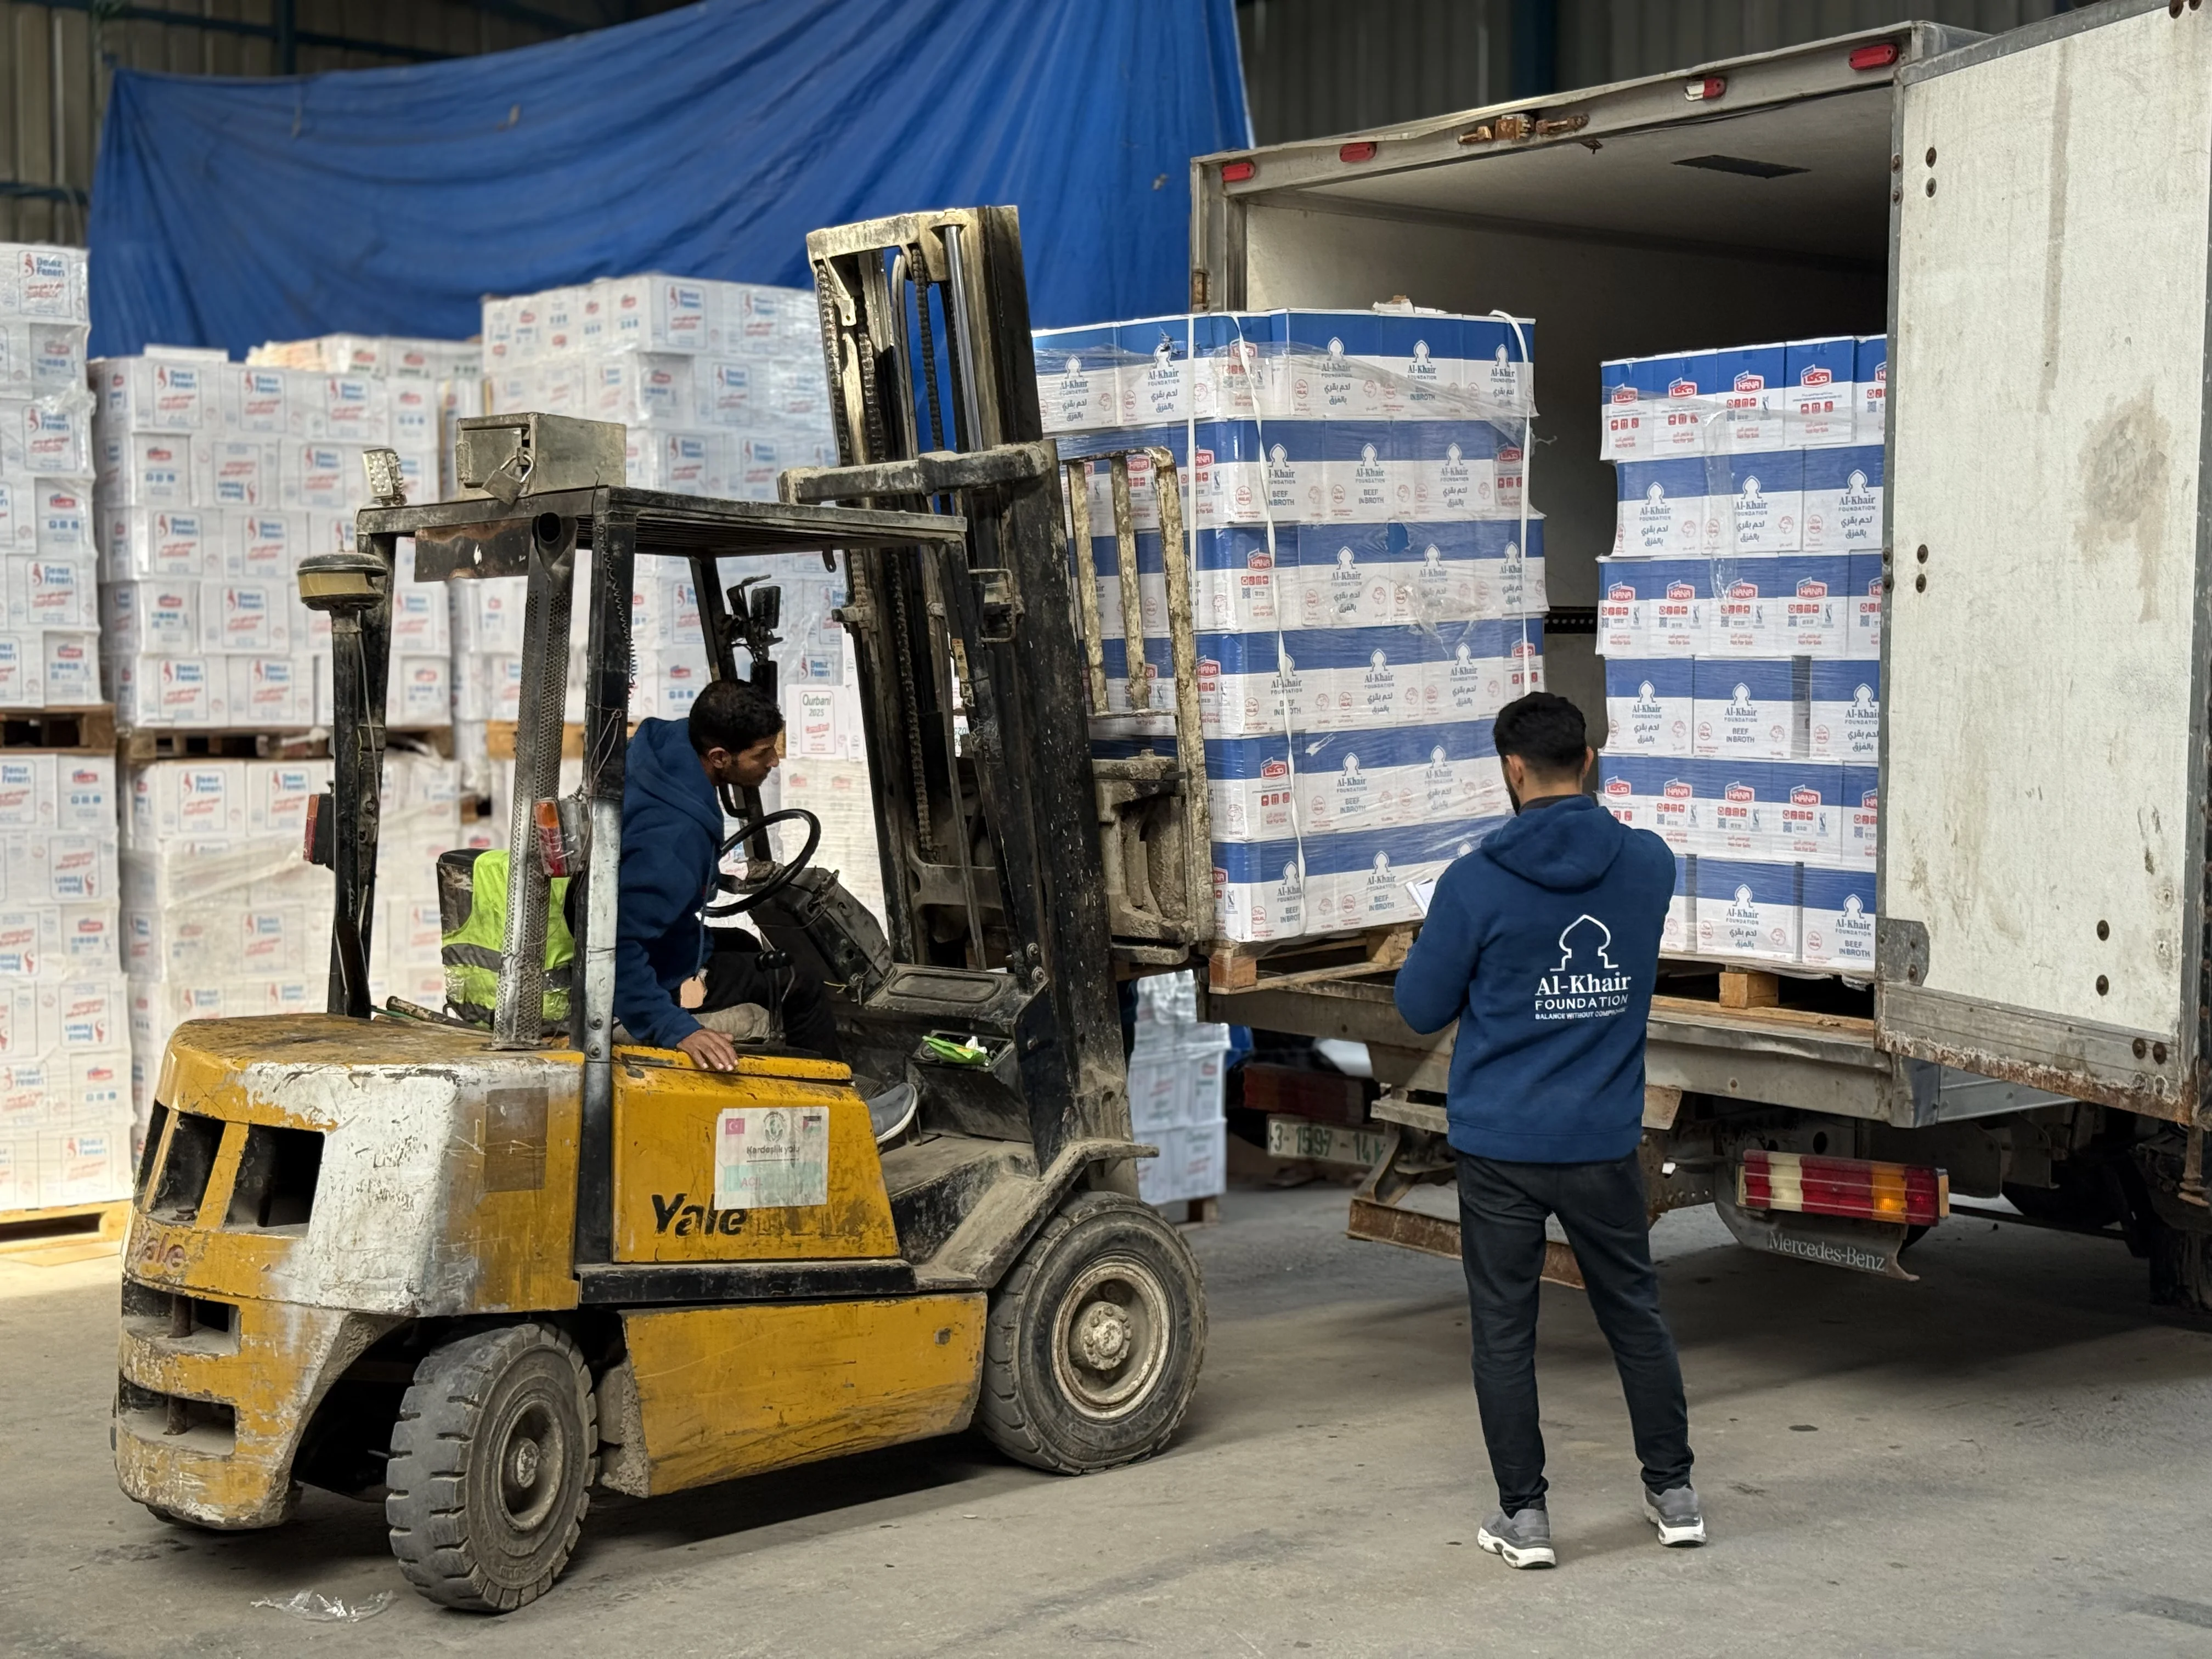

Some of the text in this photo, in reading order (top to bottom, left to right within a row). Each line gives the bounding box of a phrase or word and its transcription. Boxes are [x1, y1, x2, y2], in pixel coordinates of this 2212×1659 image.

[1321, 362, 1351, 372] Al-Khair
[1408, 364, 1436, 374] Al-Khair
[1148, 368, 1179, 380] Al-Khair
[1060, 379, 1089, 390] Al-Khair
[1268, 469, 1295, 478] l-Khair
[1356, 468, 1385, 477] Al-Khair
[1735, 500, 1768, 510] Al-Khair
[1839, 495, 1876, 505] Al-Khair
[1640, 506, 1671, 515] Al-Khair
[1251, 559, 1271, 567] HANA
[1500, 565, 1522, 574] Al-Khai
[1331, 571, 1361, 580] Al-Khair
[1612, 591, 1632, 599] HANA
[1670, 590, 1691, 599] HANA
[1732, 589, 1753, 597] HANA
[1800, 588, 1822, 596] HANA
[1451, 666, 1477, 676] Al-Khair
[1364, 673, 1394, 683] Al-Khair
[803, 694, 831, 706] Qurbani
[809, 708, 825, 717] 2025
[1632, 704, 1661, 713] Al-Khair
[1725, 707, 1757, 716] Al-Khair
[1846, 709, 1879, 718] Al-Khai
[1337, 776, 1367, 787] Al-Khair
[1729, 792, 1750, 800] HANA
[1794, 794, 1816, 803] HANA
[1367, 874, 1396, 885] Al-Khair
[1726, 908, 1759, 918] Al-Khair
[1836, 919, 1871, 930] Al-Khair
[1535, 972, 1632, 996] Al-Khair
[1535, 994, 1628, 1011] FOUNDATION
[652, 1193, 747, 1237] Yale
[1769, 1232, 1885, 1273] Mercedes-Benz
